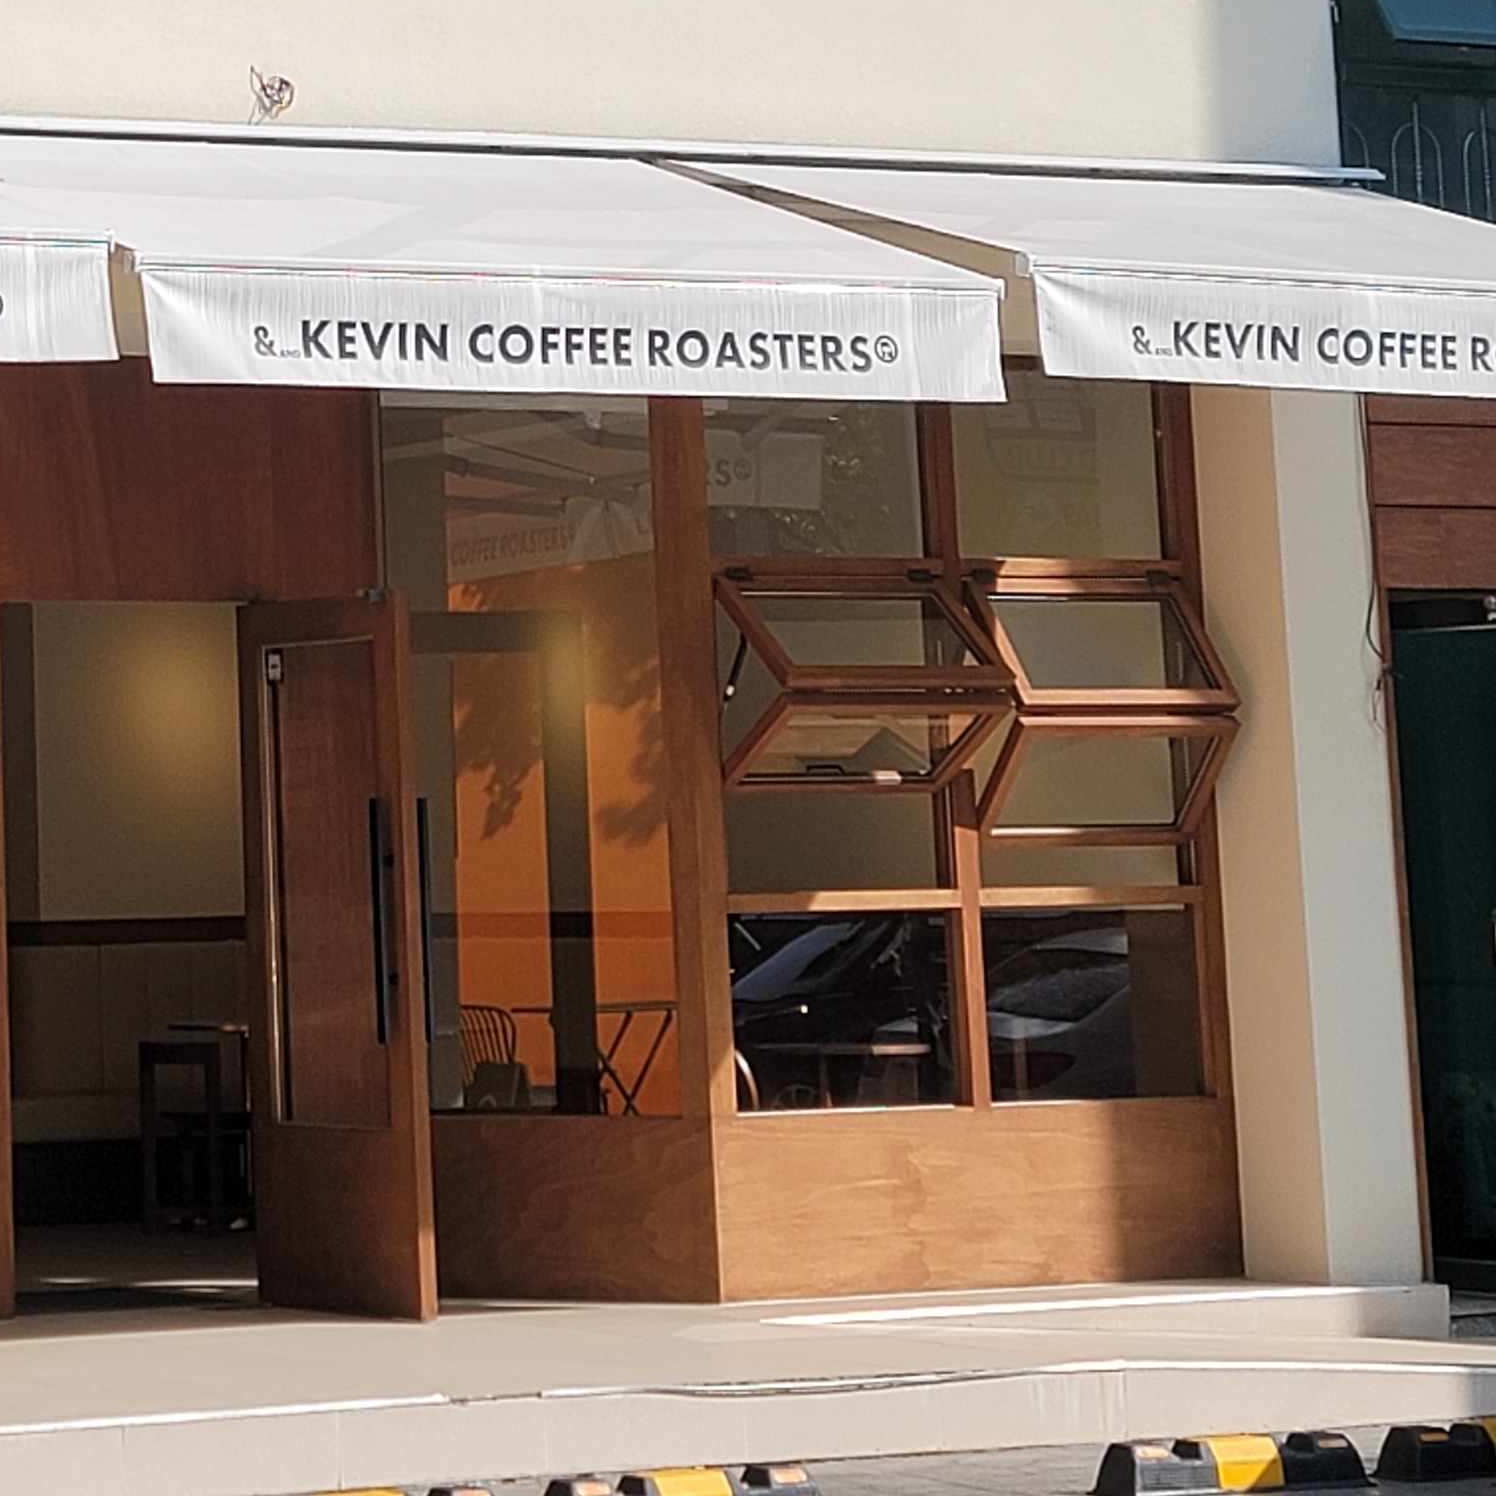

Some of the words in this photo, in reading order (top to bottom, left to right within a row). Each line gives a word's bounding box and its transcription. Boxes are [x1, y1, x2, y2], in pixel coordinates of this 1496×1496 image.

[301, 319, 449, 361] KEVIN
[468, 323, 632, 367] COFFEE
[648, 329, 872, 373] ROASTERS
[1173, 320, 1300, 362] KEVIN
[1317, 327, 1457, 371] COFFEE
